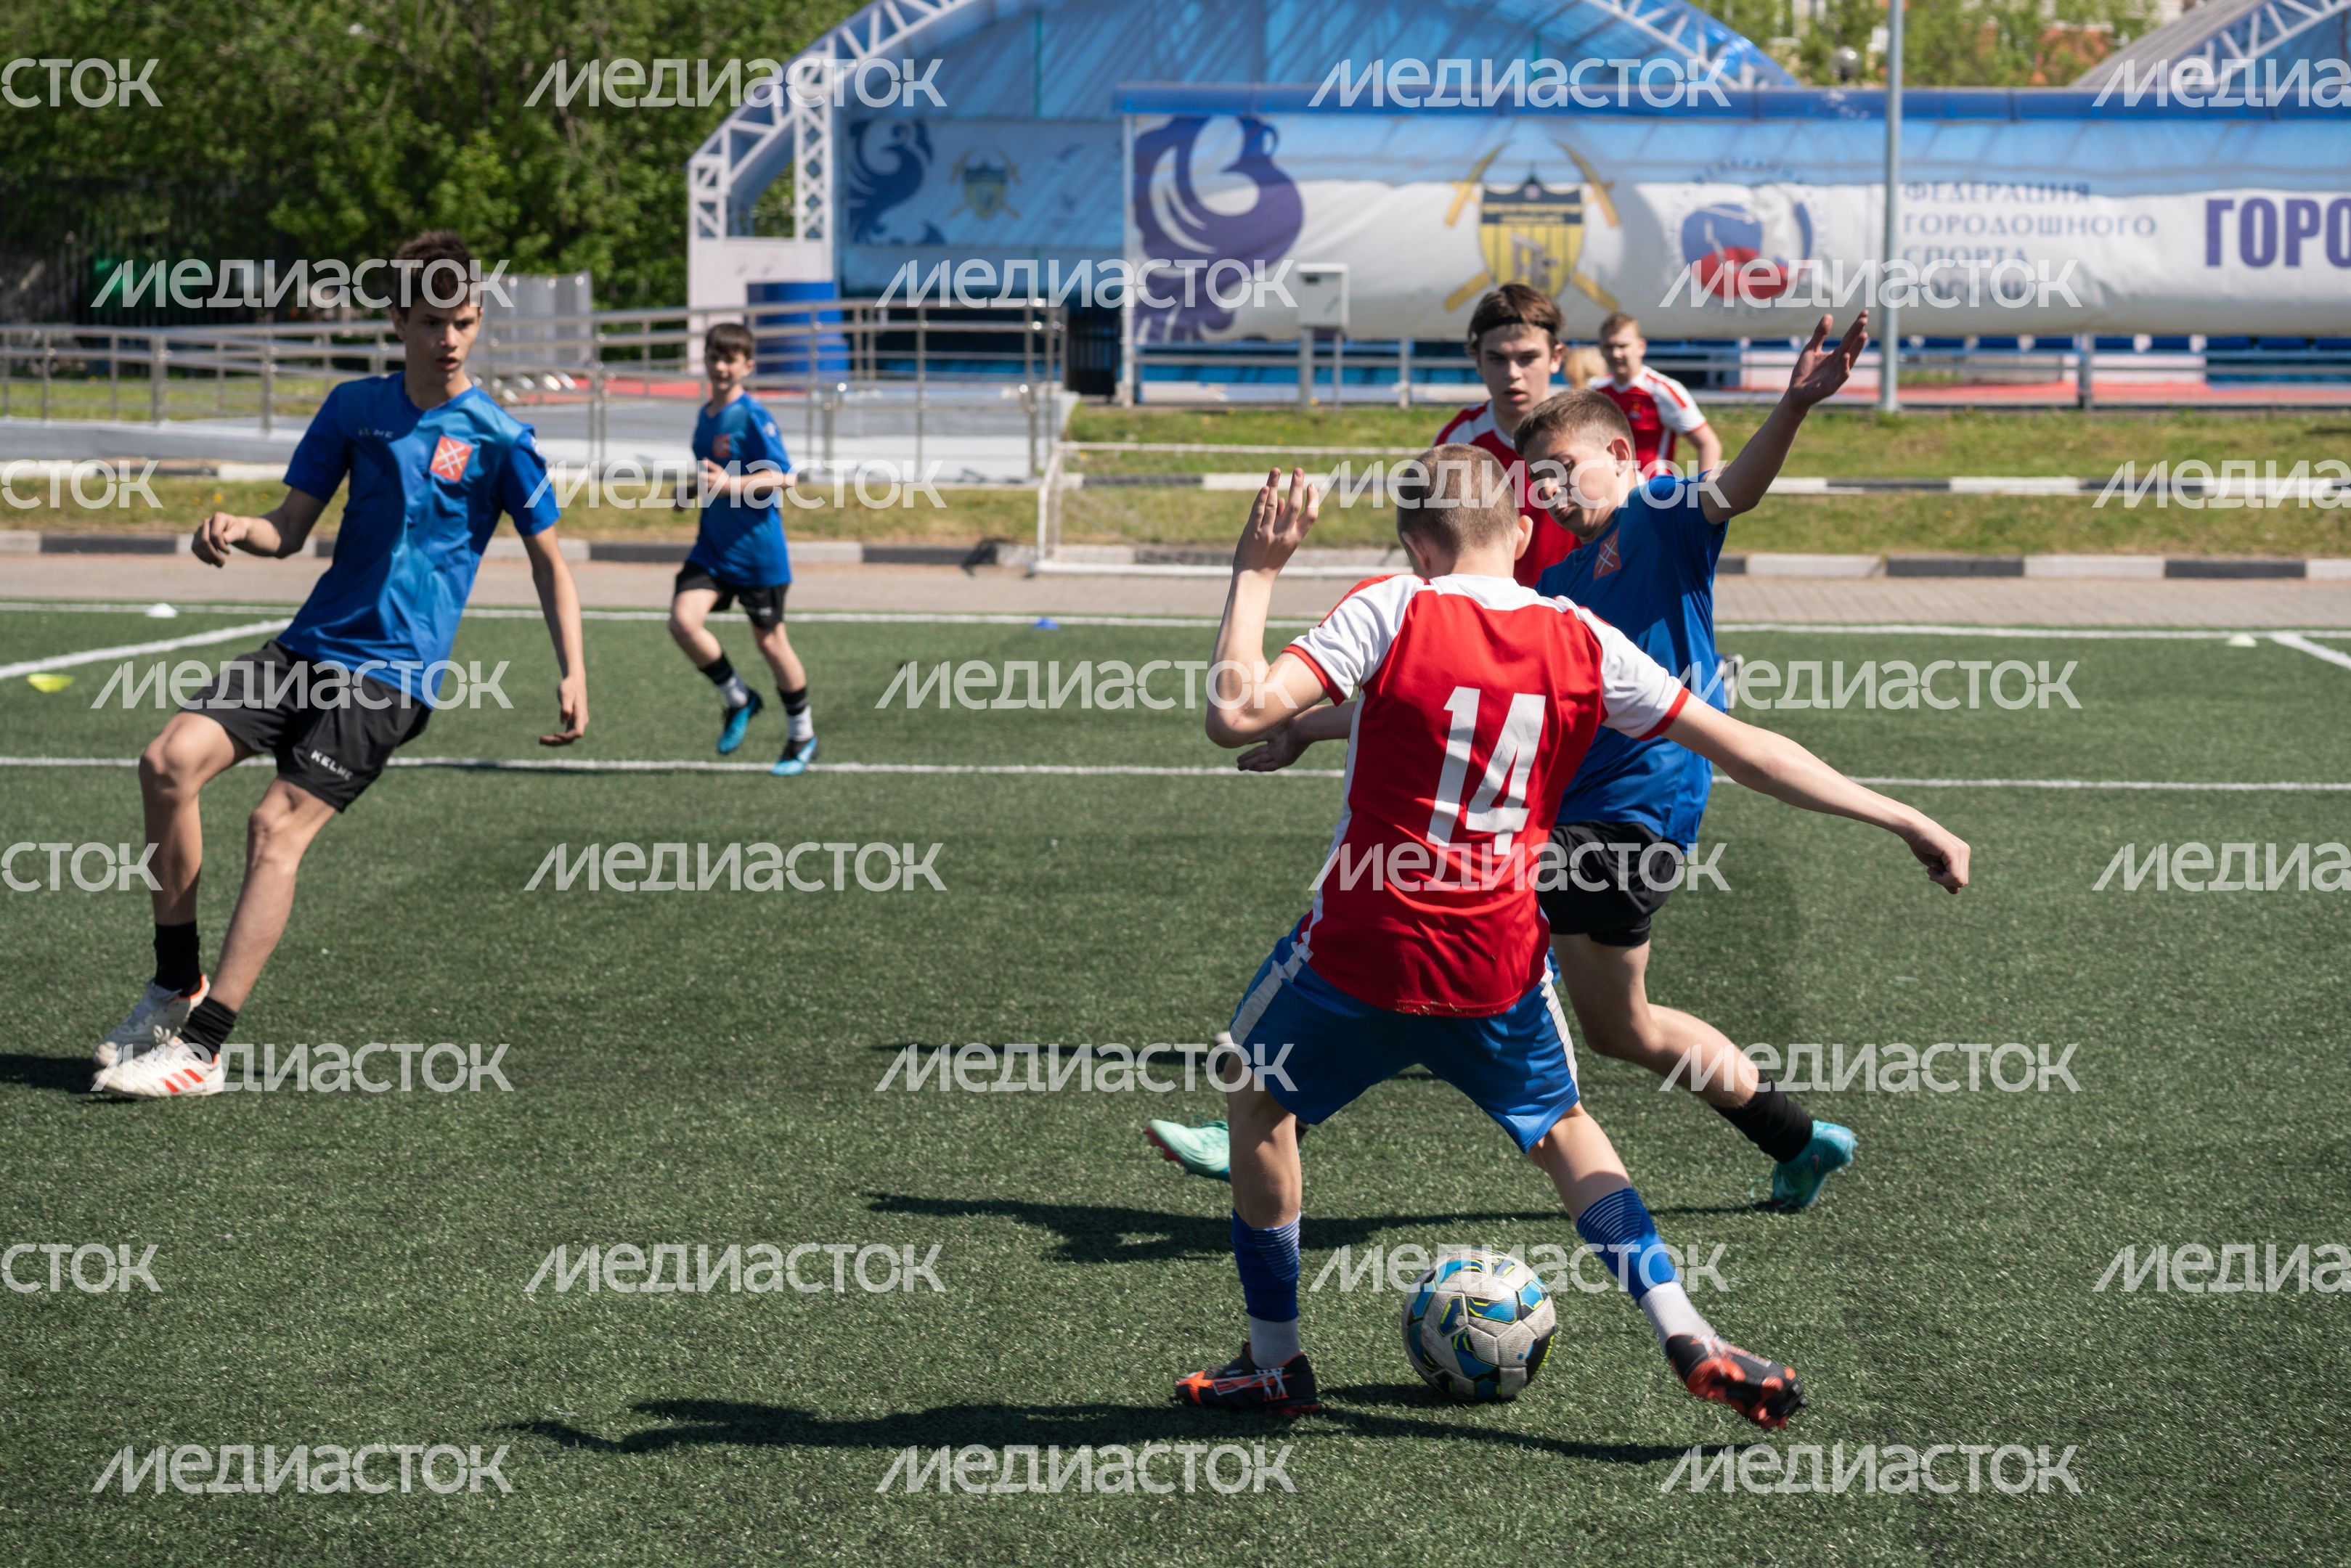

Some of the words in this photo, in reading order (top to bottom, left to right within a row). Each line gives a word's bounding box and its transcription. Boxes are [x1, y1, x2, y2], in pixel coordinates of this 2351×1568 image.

[1903, 211, 2157, 238] ГОРОДОШНОГО
[2205, 197, 2351, 269] ГОРО
[311, 749, 353, 781] KELME
[1426, 685, 1546, 855] 14
